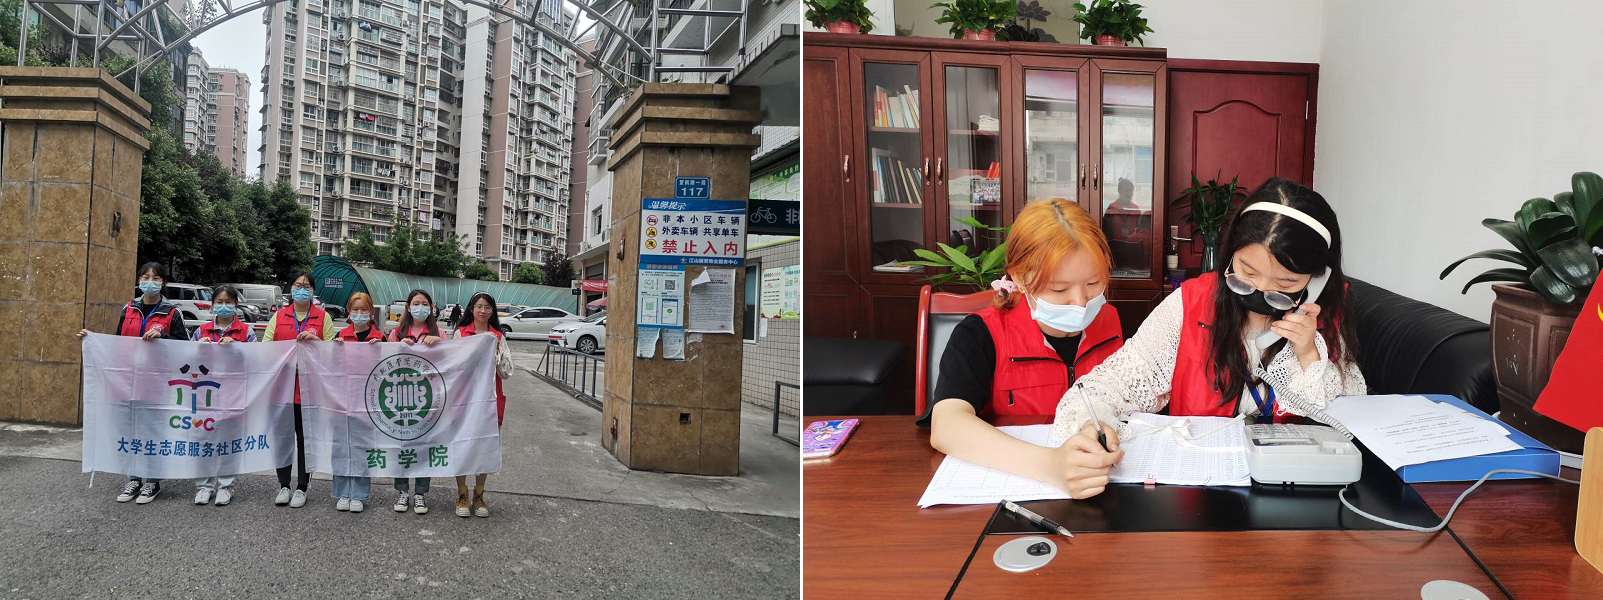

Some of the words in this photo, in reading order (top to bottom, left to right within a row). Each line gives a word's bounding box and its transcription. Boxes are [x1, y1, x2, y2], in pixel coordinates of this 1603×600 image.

[681, 187, 704, 196] 117
[650, 200, 687, 211] 温馨提示
[662, 214, 740, 226] 非本小区车辆
[661, 226, 699, 236] 外卖车辆
[702, 227, 740, 238] 共享单车
[661, 239, 739, 256] 禁止入内
[117, 434, 270, 458] 大学生志愿服务社区分队
[365, 444, 449, 470] 药学院
